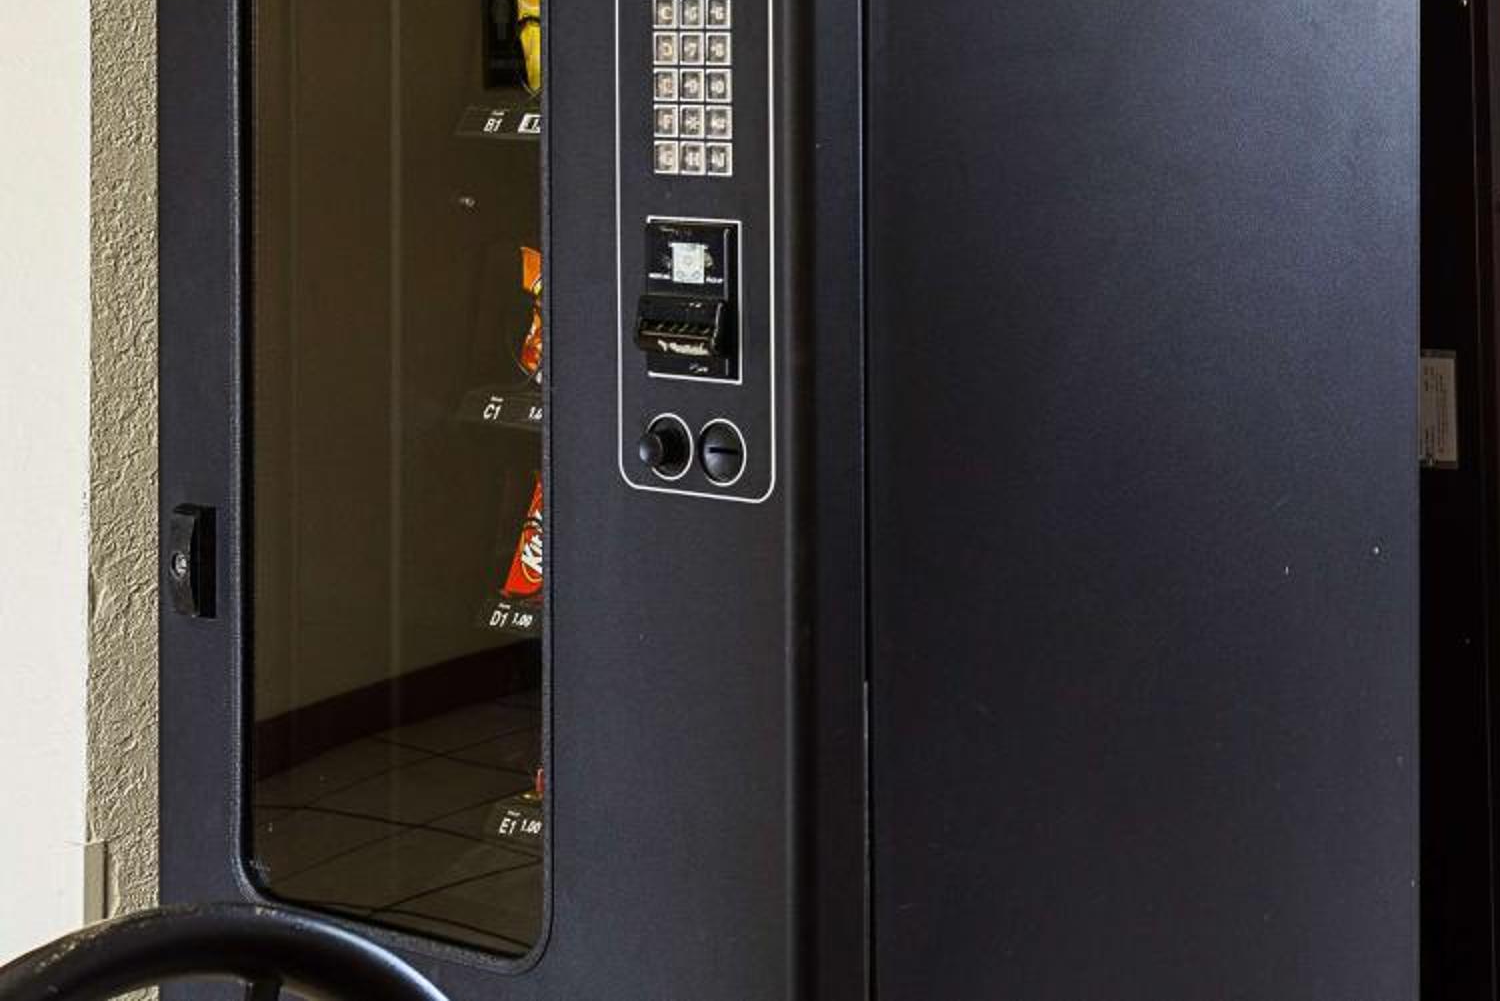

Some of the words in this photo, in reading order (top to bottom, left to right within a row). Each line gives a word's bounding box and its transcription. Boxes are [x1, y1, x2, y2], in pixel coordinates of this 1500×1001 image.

[483, 404, 502, 420] C1
[489, 610, 510, 627] D1
[512, 612, 533, 628] 1.00
[499, 816, 517, 834] E1
[521, 819, 543, 834] 1.00
